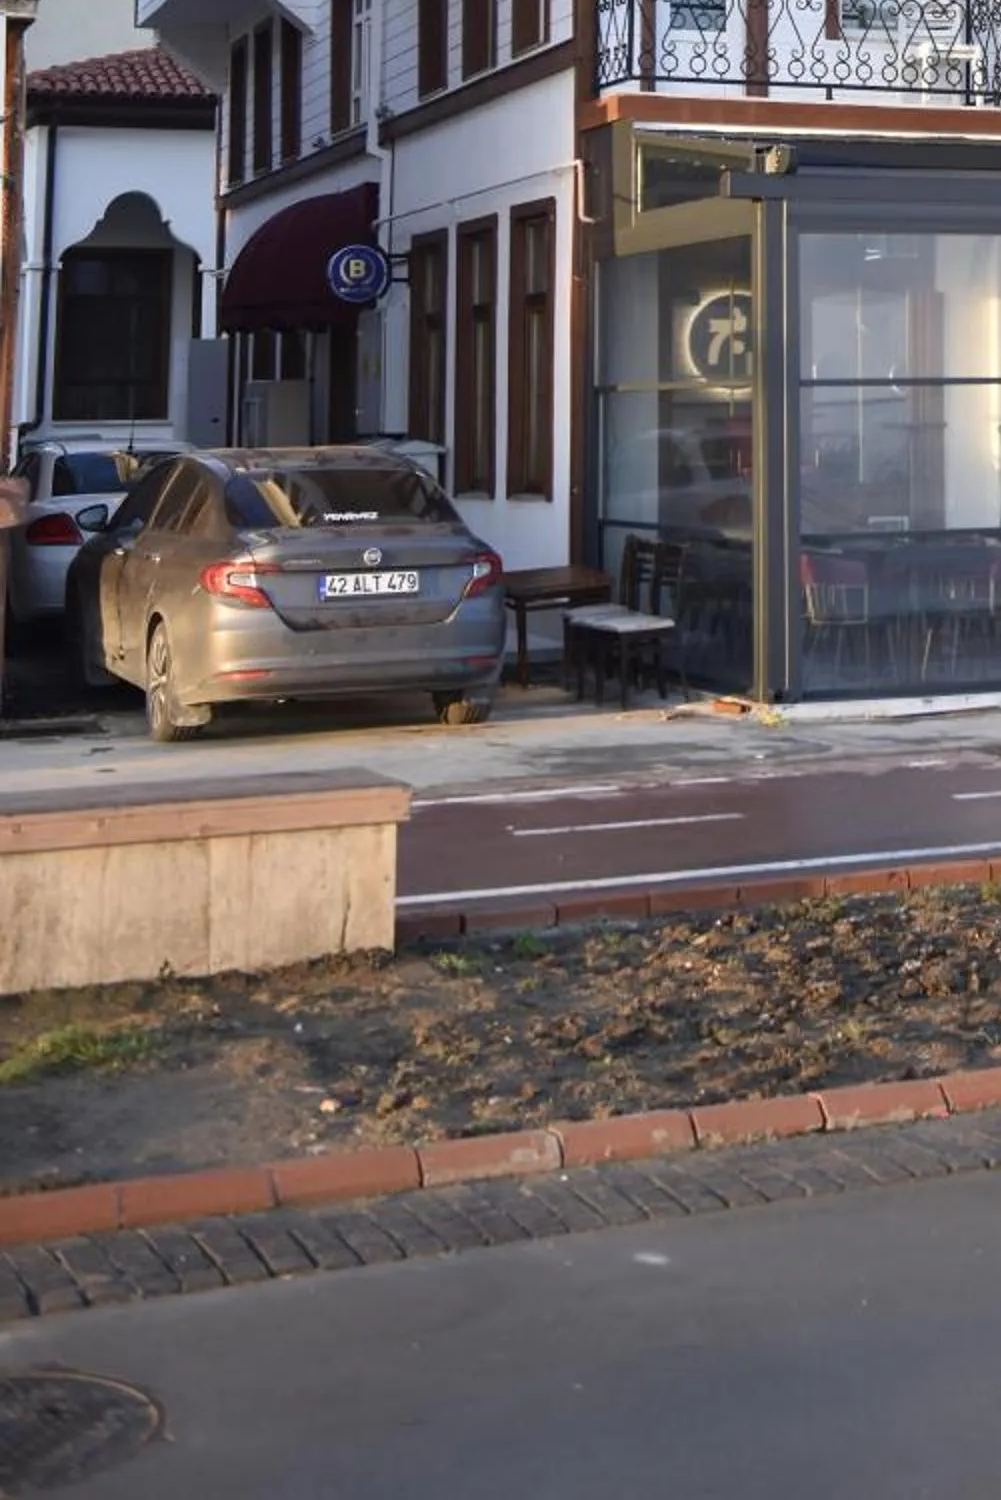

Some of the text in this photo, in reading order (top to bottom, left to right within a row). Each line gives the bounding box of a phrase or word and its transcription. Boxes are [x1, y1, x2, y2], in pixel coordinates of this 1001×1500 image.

[349, 259, 366, 278] B
[328, 573, 417, 593] 42 ALT 479
